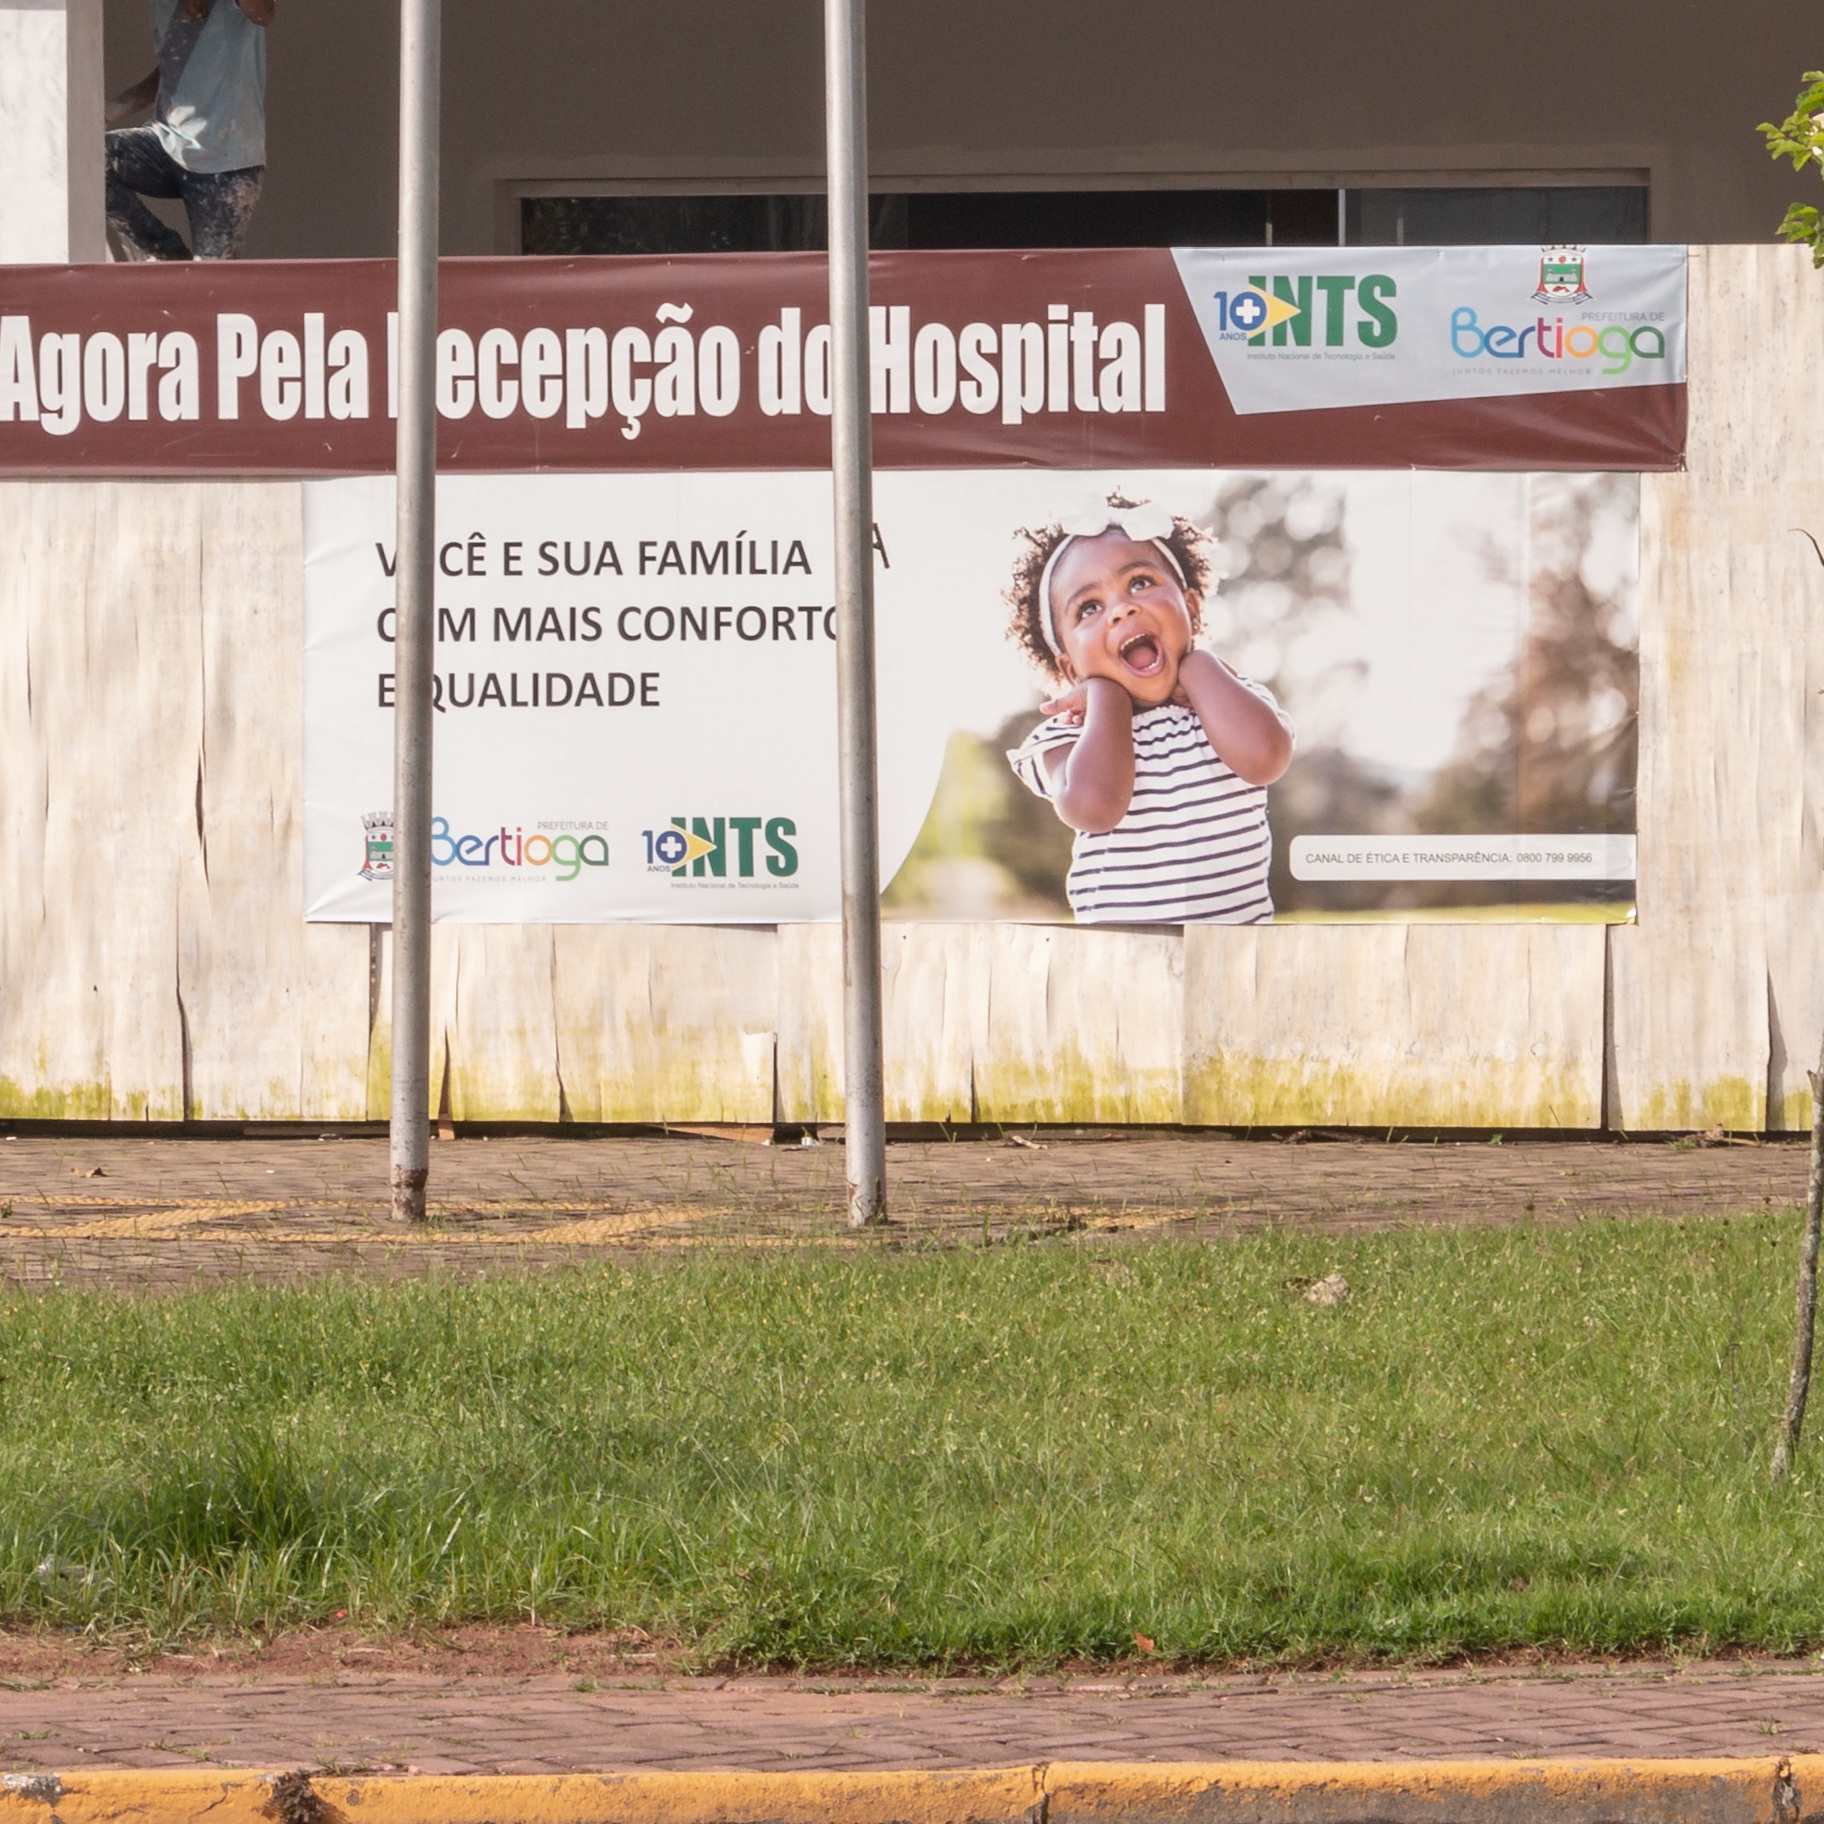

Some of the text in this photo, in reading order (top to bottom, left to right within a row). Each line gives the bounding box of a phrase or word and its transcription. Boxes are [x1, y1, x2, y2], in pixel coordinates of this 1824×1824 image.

[1248, 275, 1397, 347] INTS
[1581, 312, 1665, 322] PREFEITURA DE
[1219, 332, 1247, 341] ANOS
[1451, 306, 1665, 375] Bertioga
[217, 312, 369, 421] Pela
[387, 302, 740, 439] ecepção
[868, 303, 1166, 425] Hospital
[1324, 352, 1362, 361] Tecnologia
[1372, 352, 1396, 360] Saúde
[375, 532, 486, 577] VCÊ
[503, 542, 523, 576] E
[538, 540, 623, 576] SUA
[639, 529, 812, 575] FAMÍLIA
[377, 607, 476, 642] CM
[493, 606, 602, 642] MAIS
[378, 674, 395, 707] E
[538, 821, 608, 830] PREFEITURA DE
[431, 816, 609, 881] Bertioga
[671, 817, 798, 877] INTS
[1305, 852, 1592, 864] CANAL DE ÉTICA E TRANSPARÊNCIA: 0800 799 9956
[738, 882, 772, 890] Tecnologia
